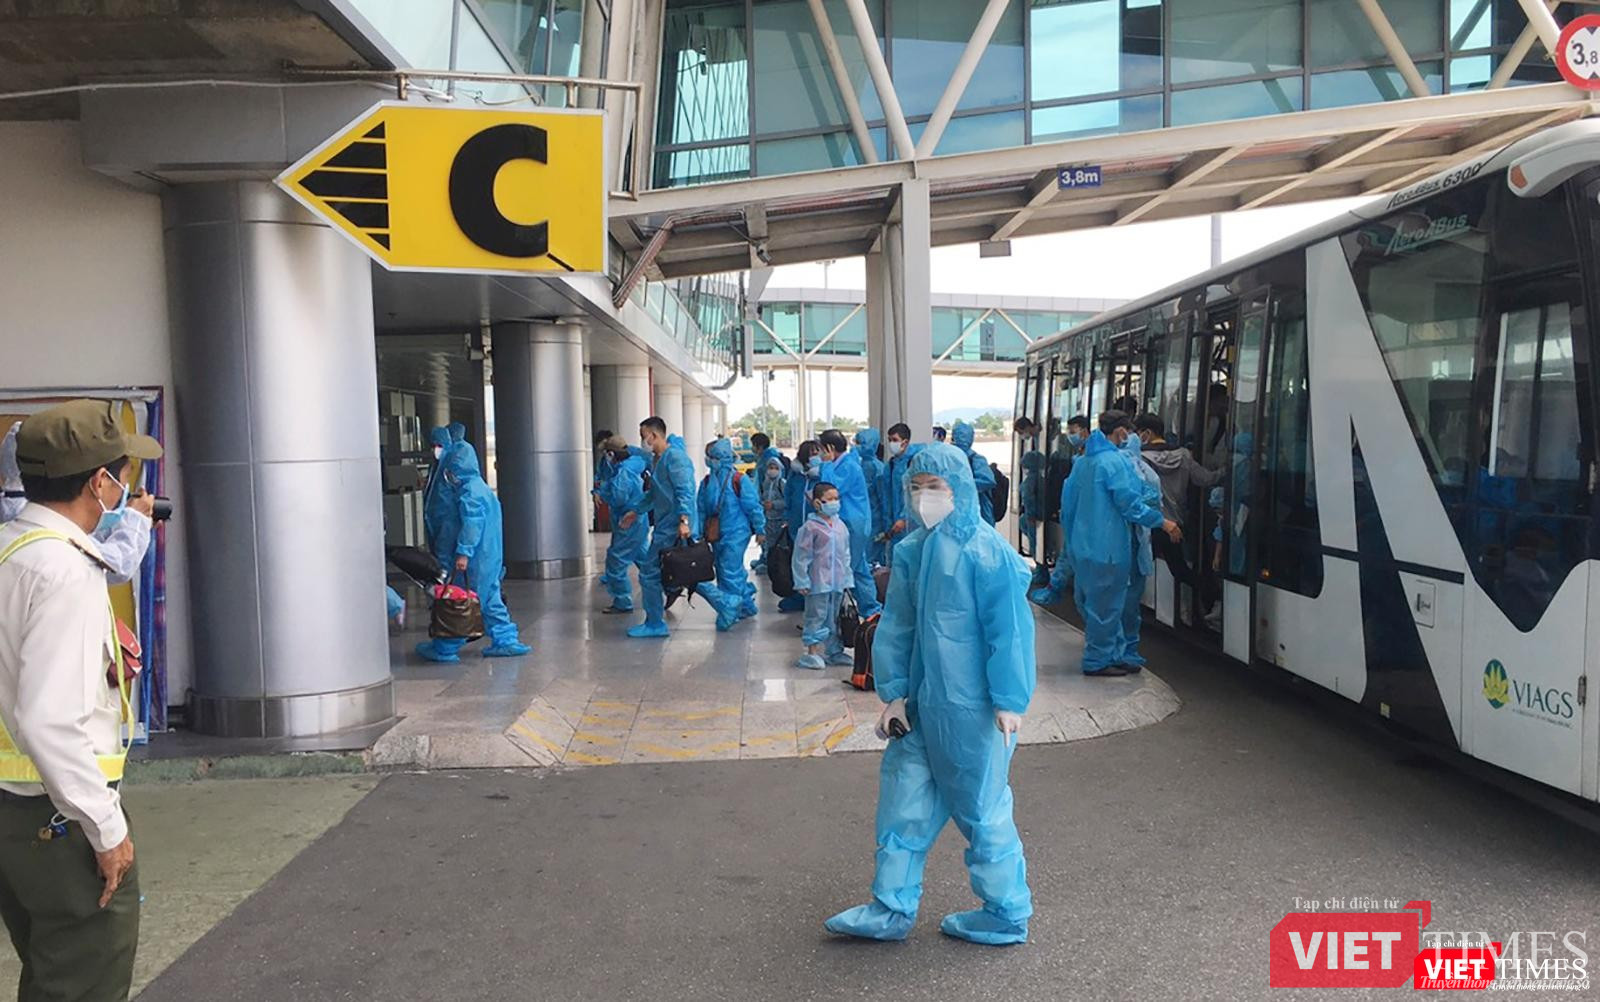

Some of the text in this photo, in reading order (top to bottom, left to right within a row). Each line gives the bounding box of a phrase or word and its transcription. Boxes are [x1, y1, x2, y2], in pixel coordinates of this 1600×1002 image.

[449, 123, 549, 258] C
[1061, 170, 1099, 187] 3,8m
[1442, 162, 1483, 188] 6300
[1513, 679, 1574, 719] VIAGS
